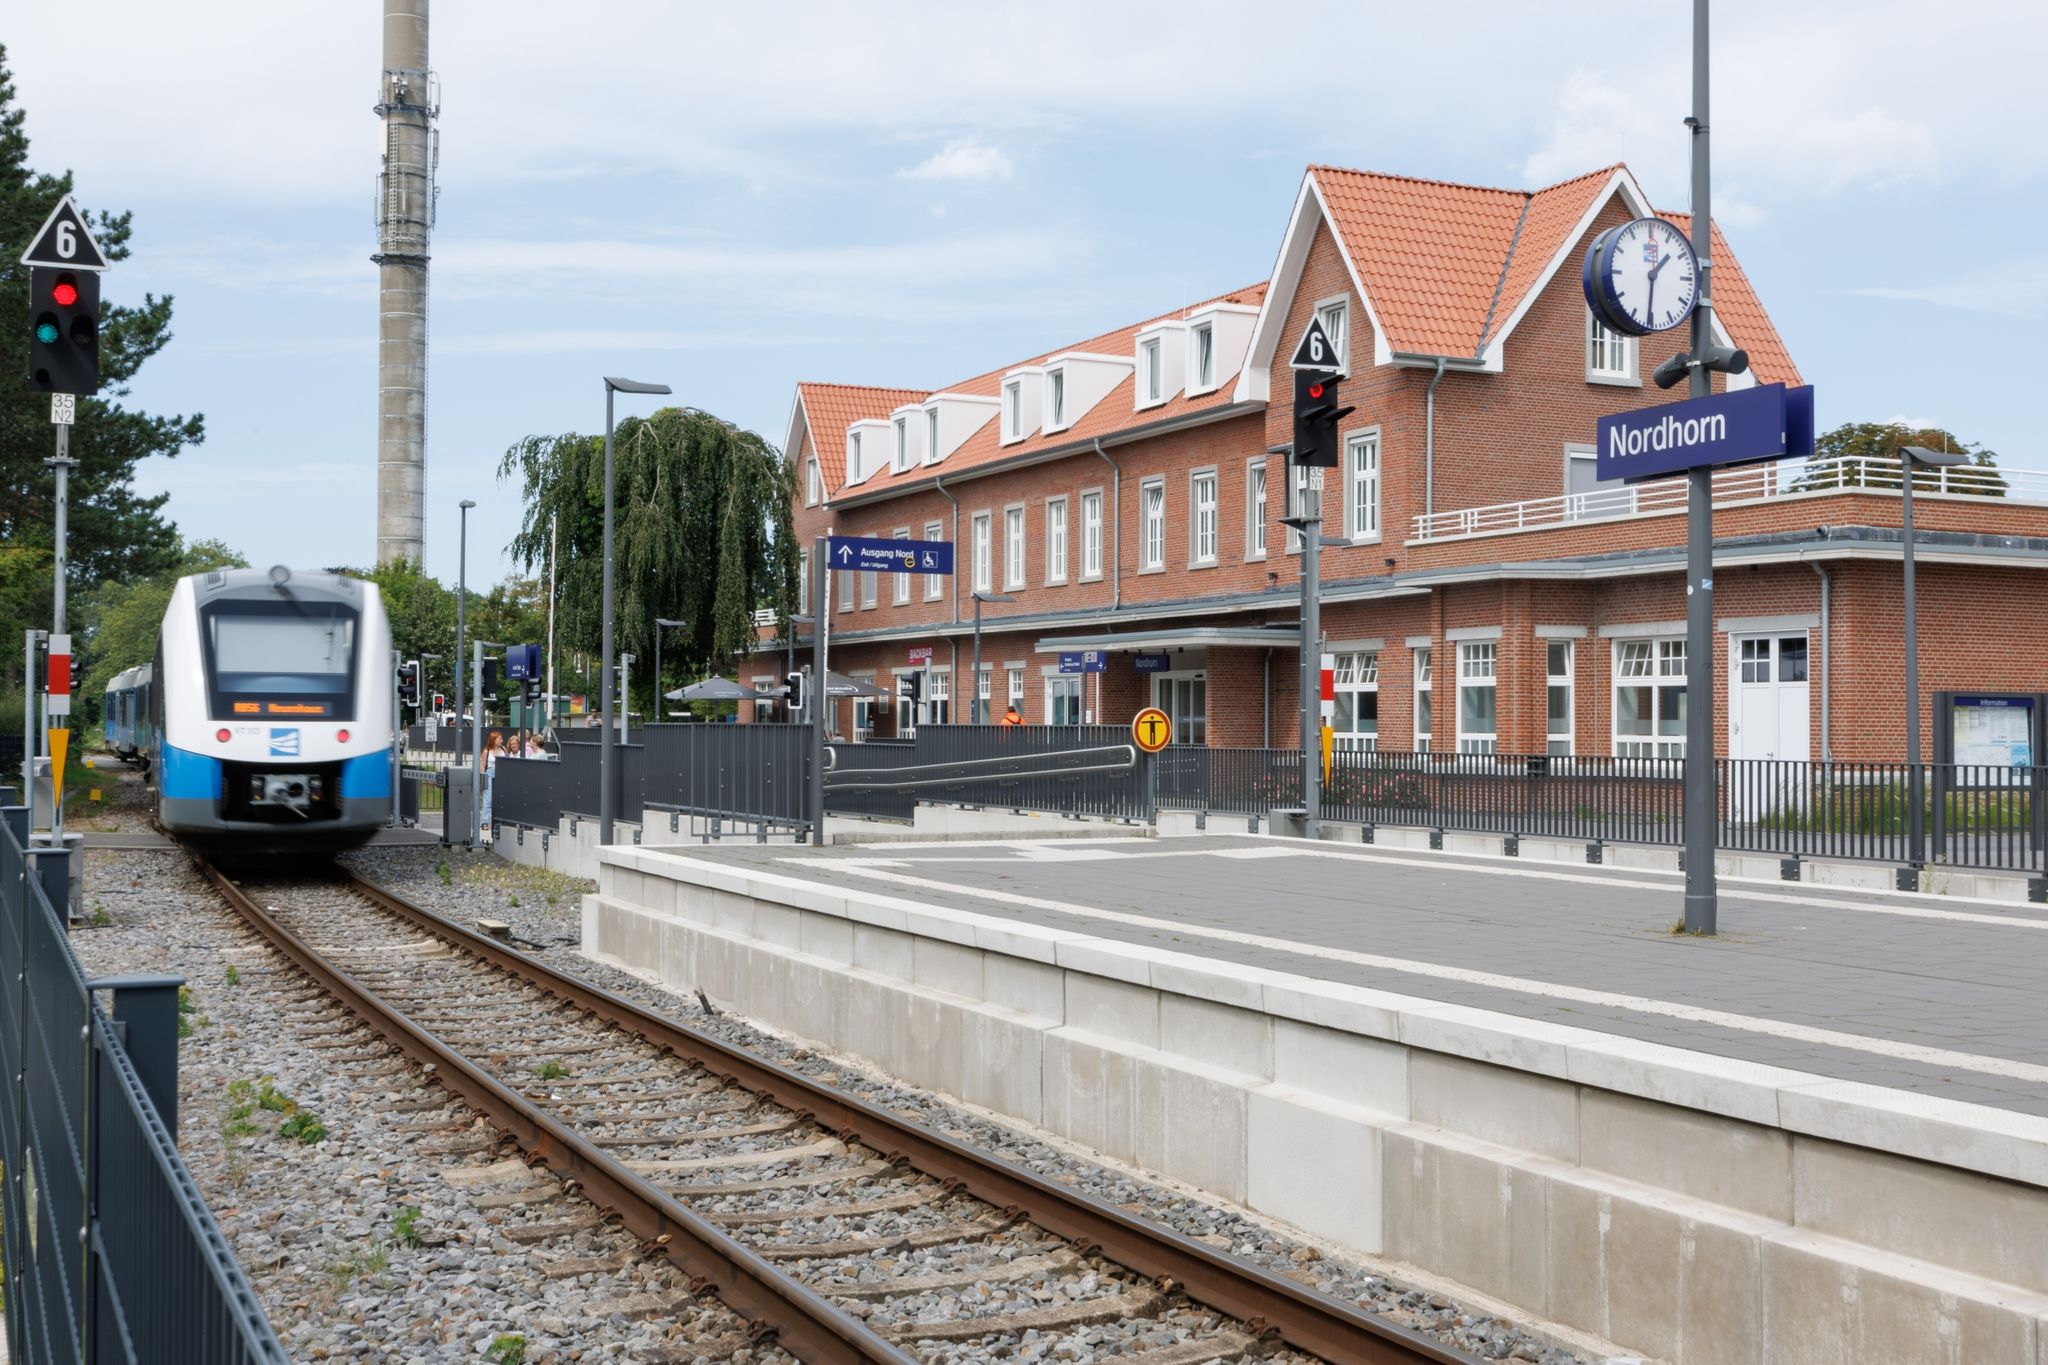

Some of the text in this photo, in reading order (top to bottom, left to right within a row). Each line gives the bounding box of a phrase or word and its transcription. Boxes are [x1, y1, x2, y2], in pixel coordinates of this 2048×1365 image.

[56, 220, 77, 259] 6
[1310, 331, 1323, 362] 6
[53, 394, 74, 408] 35
[54, 409, 73, 423] N2
[1610, 413, 1726, 458] Nordhorn
[1310, 467, 1323, 478] 35
[1311, 479, 1323, 489] N1
[860, 547, 914, 559] Ausgang Nord
[1135, 657, 1159, 668] Nordhorn
[1980, 698, 2008, 706] Information
